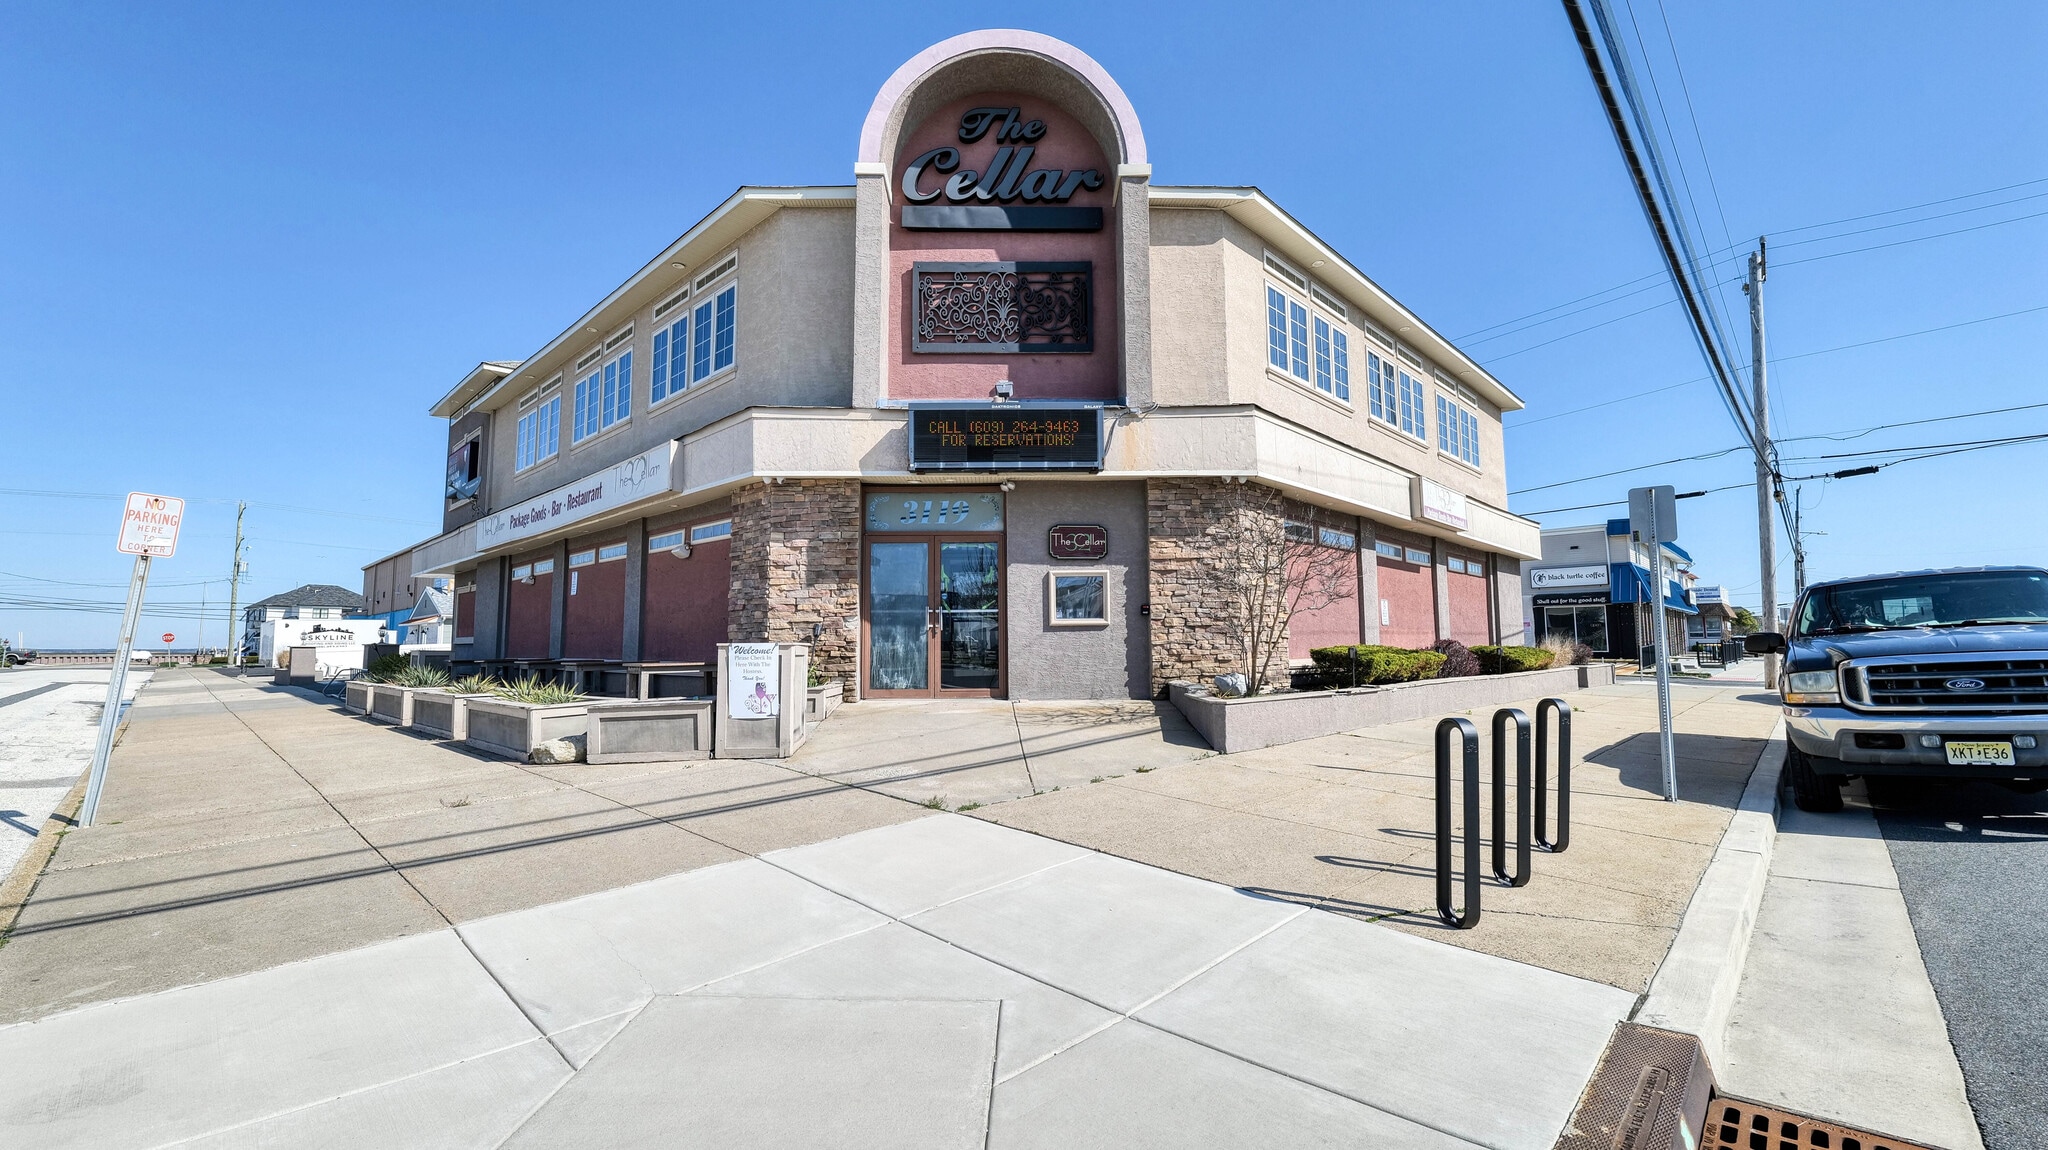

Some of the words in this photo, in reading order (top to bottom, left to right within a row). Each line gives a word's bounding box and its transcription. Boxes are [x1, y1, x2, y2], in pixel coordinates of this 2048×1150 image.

[959, 107, 1047, 144] The
[901, 146, 1104, 204] Cellar
[929, 421, 961, 434] CALL
[970, 421, 1004, 434] (609)
[1012, 421, 1079, 433] 264-9463
[942, 434, 966, 446] FOR
[975, 434, 1074, 447] RESERVATIONS!
[145, 498, 166, 511] NO
[509, 512, 530, 530] Package
[530, 504, 547, 523] Goods
[551, 500, 562, 517] Bar
[567, 481, 603, 511] Restaurant
[127, 510, 178, 526] PARKING
[900, 500, 970, 525] 3119
[138, 525, 163, 534] HERE
[1051, 532, 1071, 547] The
[1073, 532, 1106, 547] Cellar
[1547, 573, 1565, 581] black
[1585, 571, 1605, 580] coffee
[734, 645, 777, 654] Welcome!
[1951, 748, 1973, 759] XKT
[1984, 748, 2008, 759] E36
